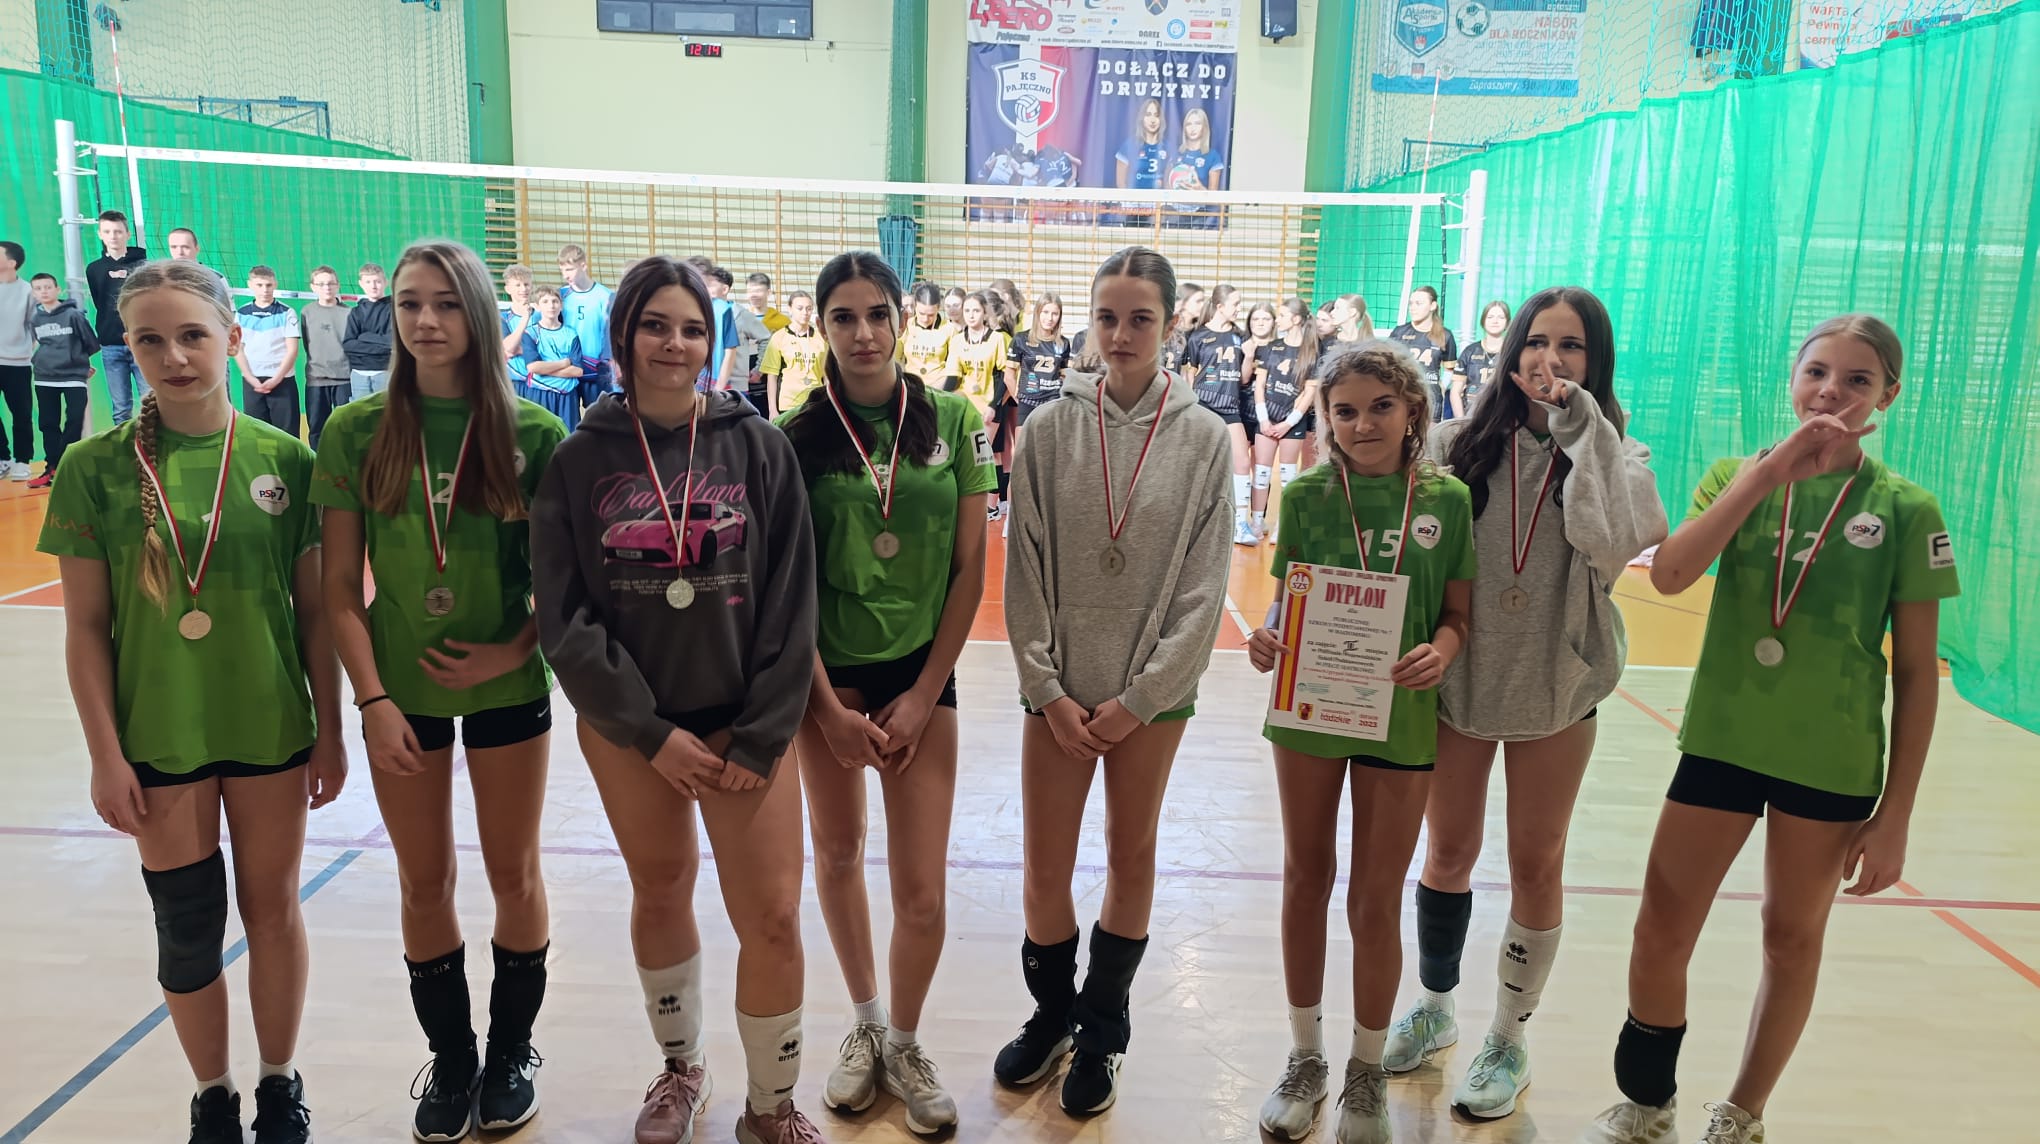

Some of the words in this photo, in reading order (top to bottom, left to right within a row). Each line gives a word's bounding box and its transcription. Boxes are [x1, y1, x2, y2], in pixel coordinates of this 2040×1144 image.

[1020, 71, 1037, 81] KS
[1098, 60, 1189, 82] DOŁĄCZ
[1198, 63, 1226, 79] DO
[1100, 79, 1221, 100] DRUŻYNY!
[577, 305, 585, 321] 5
[1215, 346, 1236, 364] 14
[1033, 355, 1056, 374] 23
[1277, 358, 1292, 376] 4
[1361, 529, 1402, 558] 15
[1292, 582, 1308, 590] SZS
[1324, 582, 1387, 609] DYPLOM
